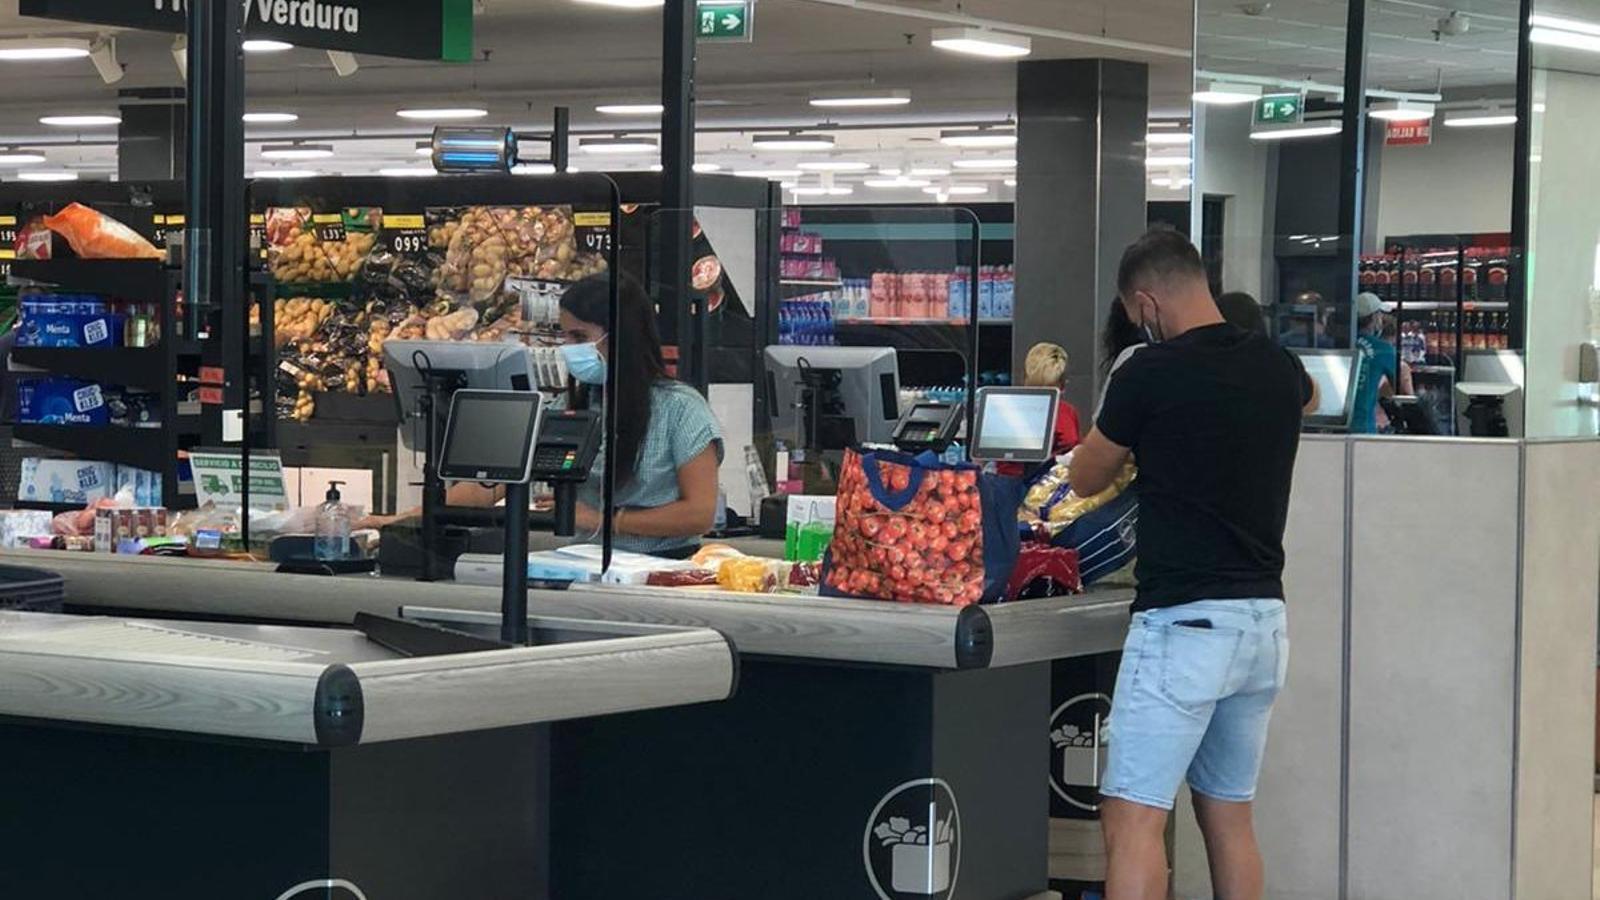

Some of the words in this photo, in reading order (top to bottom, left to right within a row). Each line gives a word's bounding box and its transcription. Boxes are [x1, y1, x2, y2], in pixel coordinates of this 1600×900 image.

[256, 0, 359, 33] Verdura
[46, 323, 70, 334] Menta
[64, 412, 91, 423] Menta
[231, 460, 237, 468] A
